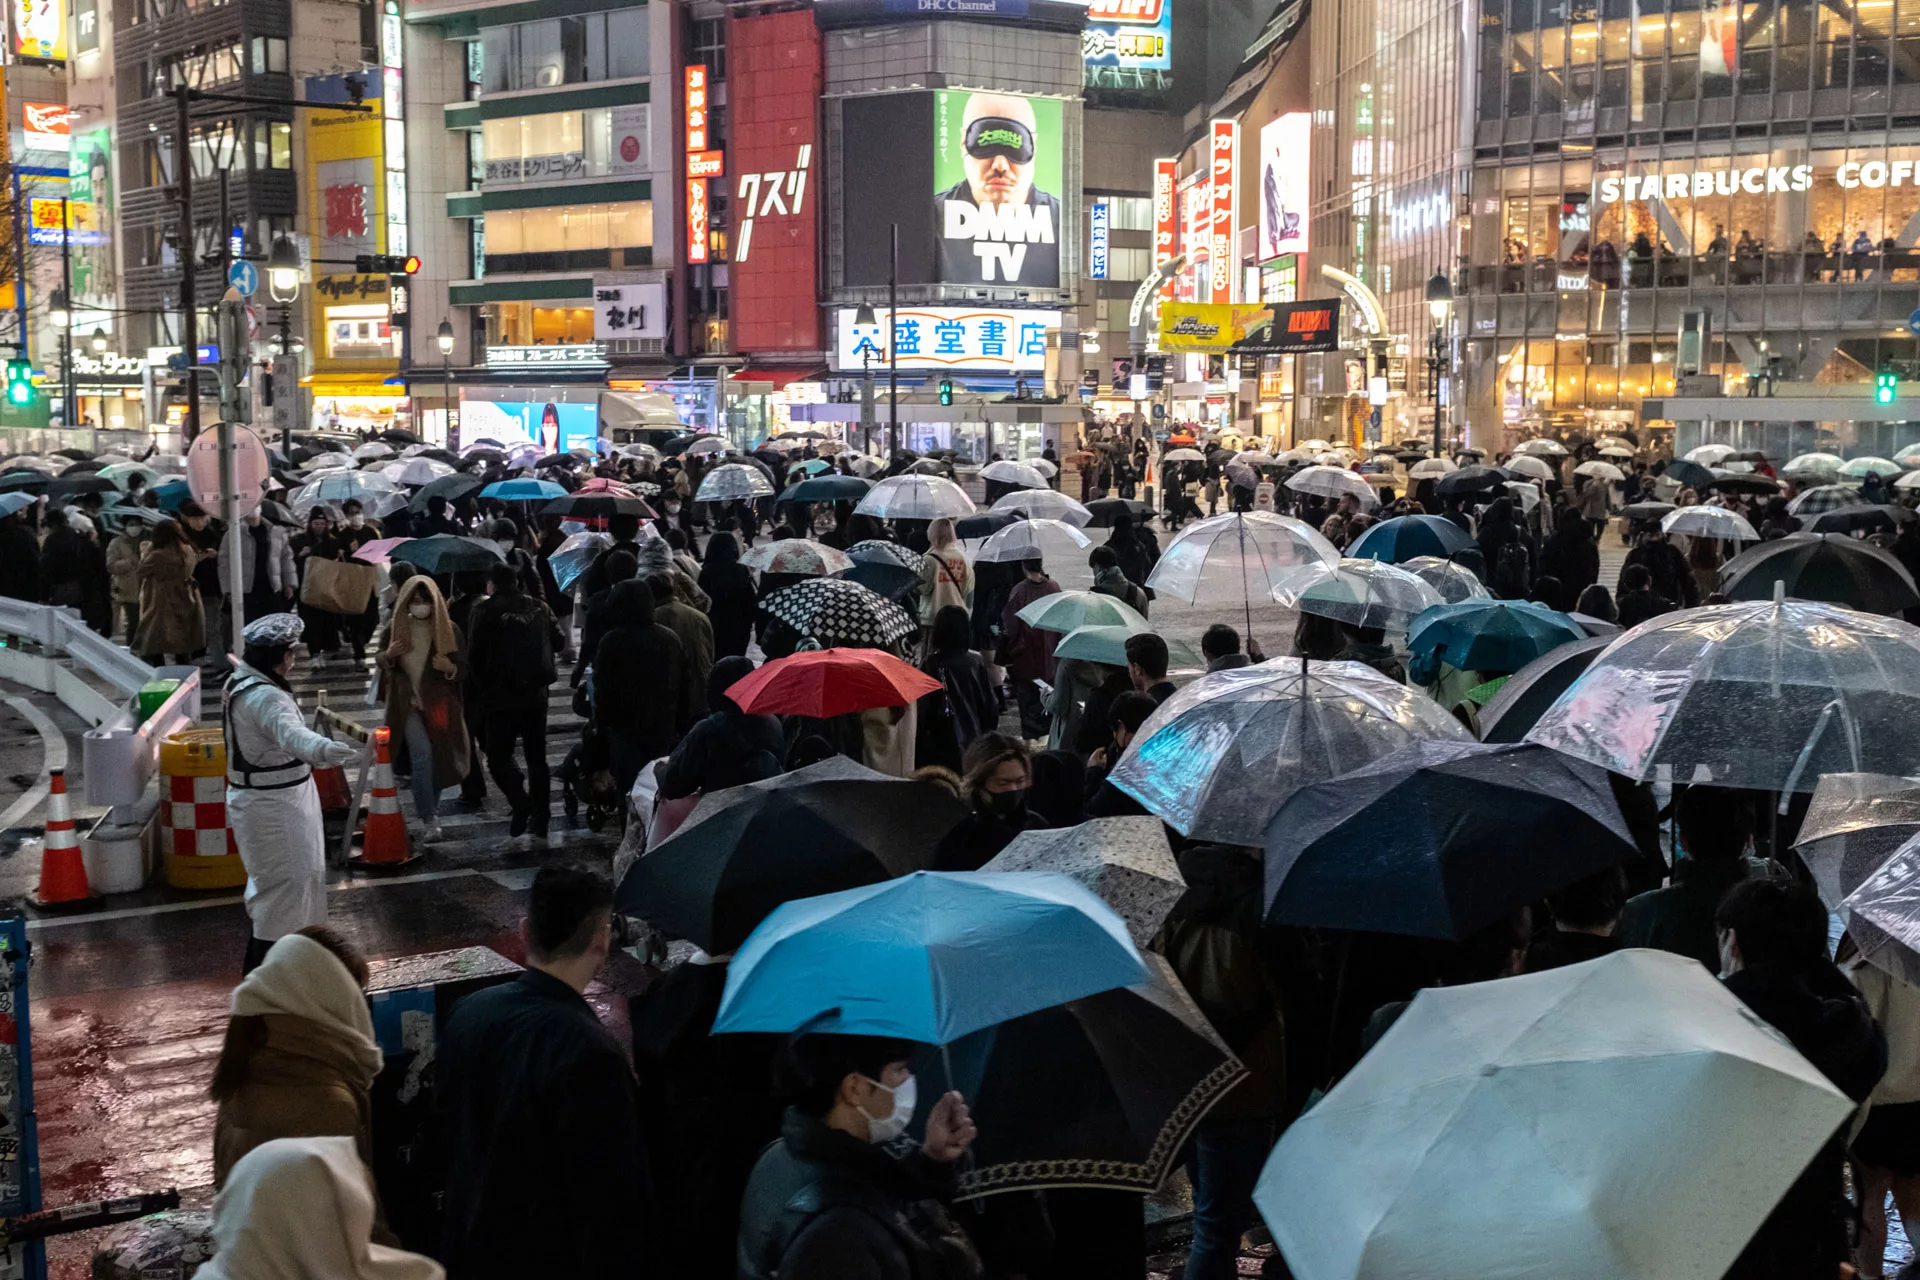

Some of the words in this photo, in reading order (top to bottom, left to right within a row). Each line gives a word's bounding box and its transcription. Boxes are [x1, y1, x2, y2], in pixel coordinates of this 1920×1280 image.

[79, 10, 95, 35] 7F
[918, 0, 944, 10] DHC
[947, 0, 996, 11] Channel
[1215, 133, 1232, 224] カラオケ
[1601, 164, 1813, 203] STARBUCKS
[944, 199, 1055, 244] DMM
[973, 242, 1028, 282] TV
